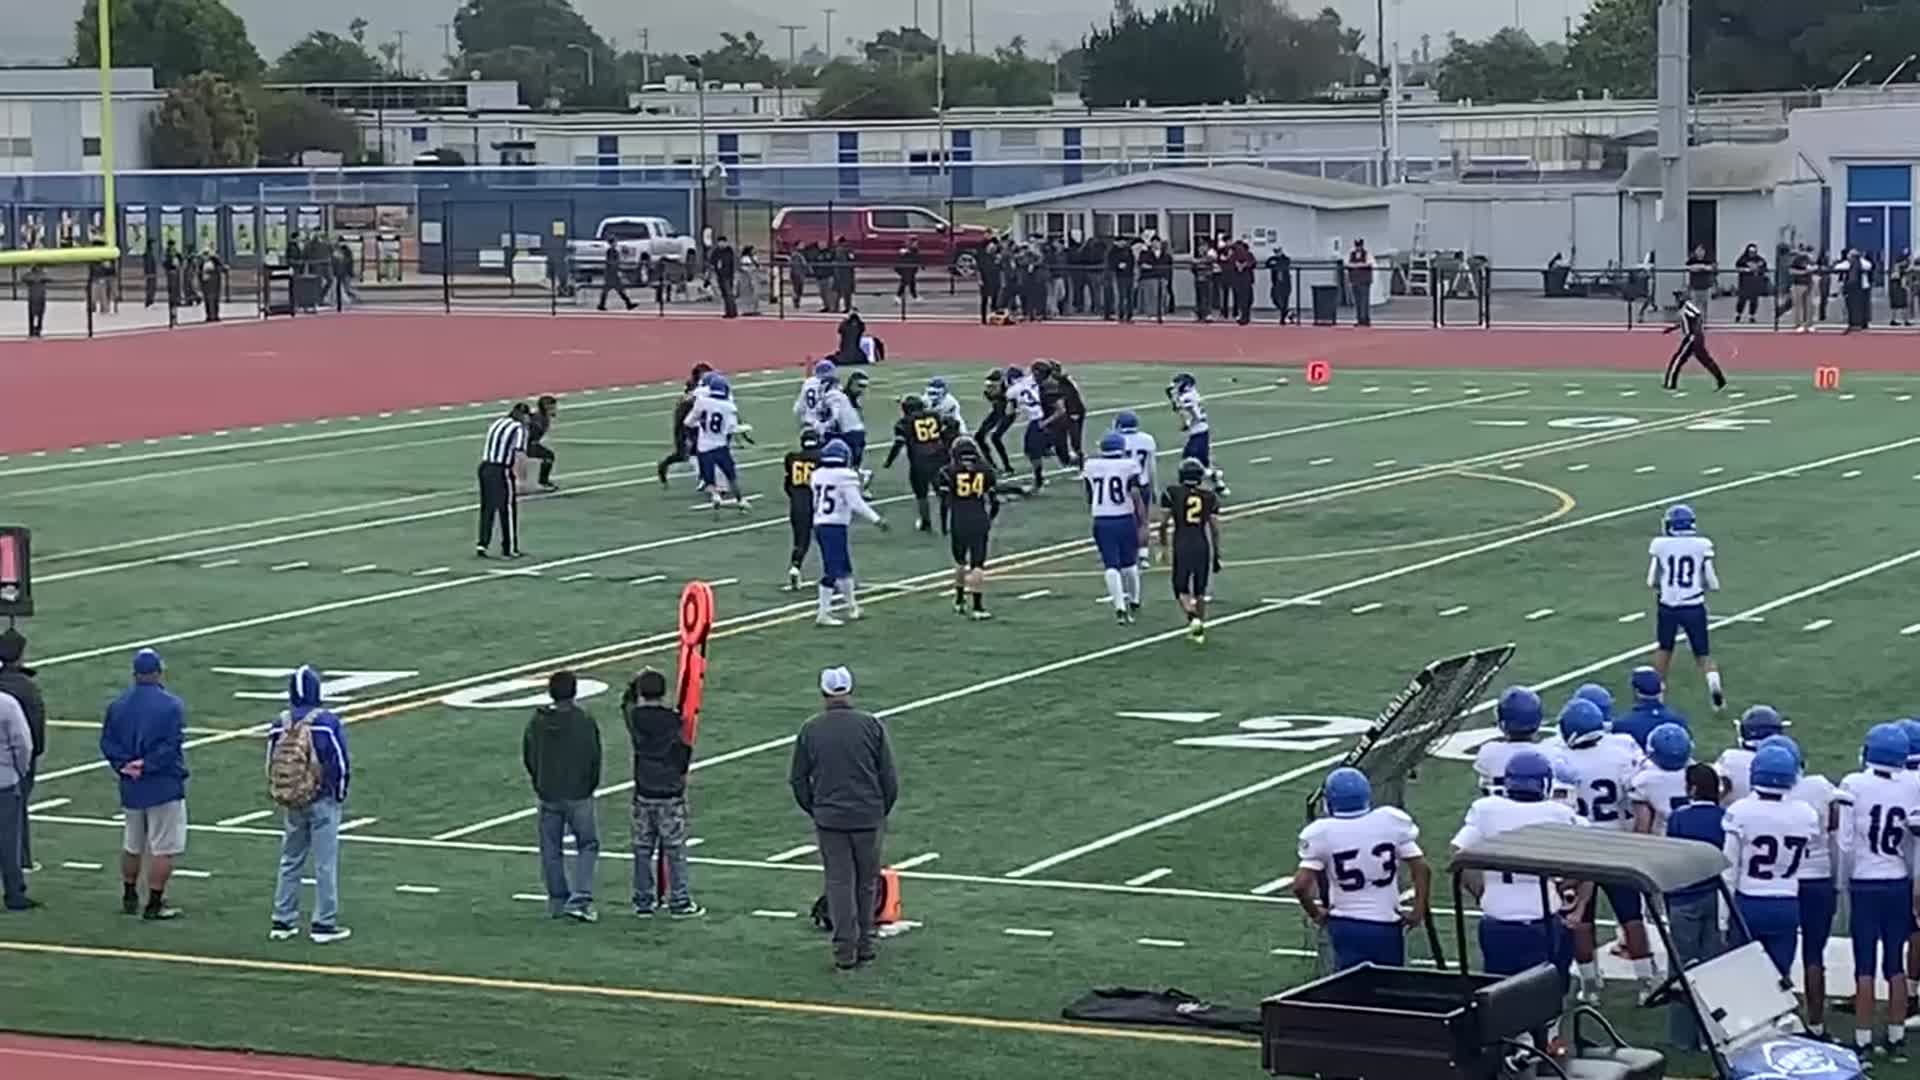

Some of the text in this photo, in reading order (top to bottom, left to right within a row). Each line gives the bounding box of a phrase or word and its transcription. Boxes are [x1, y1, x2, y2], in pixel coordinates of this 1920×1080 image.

[1818, 369, 1836, 387] 10
[913, 416, 941, 442] 62
[814, 484, 836, 515] 75
[955, 472, 985, 497] 54
[1092, 475, 1126, 506] 78
[1185, 495, 1203, 524] 2
[1667, 554, 1696, 588] 10
[1868, 803, 1906, 857] 16
[1332, 841, 1398, 892] 53
[1748, 834, 1809, 881] 27
